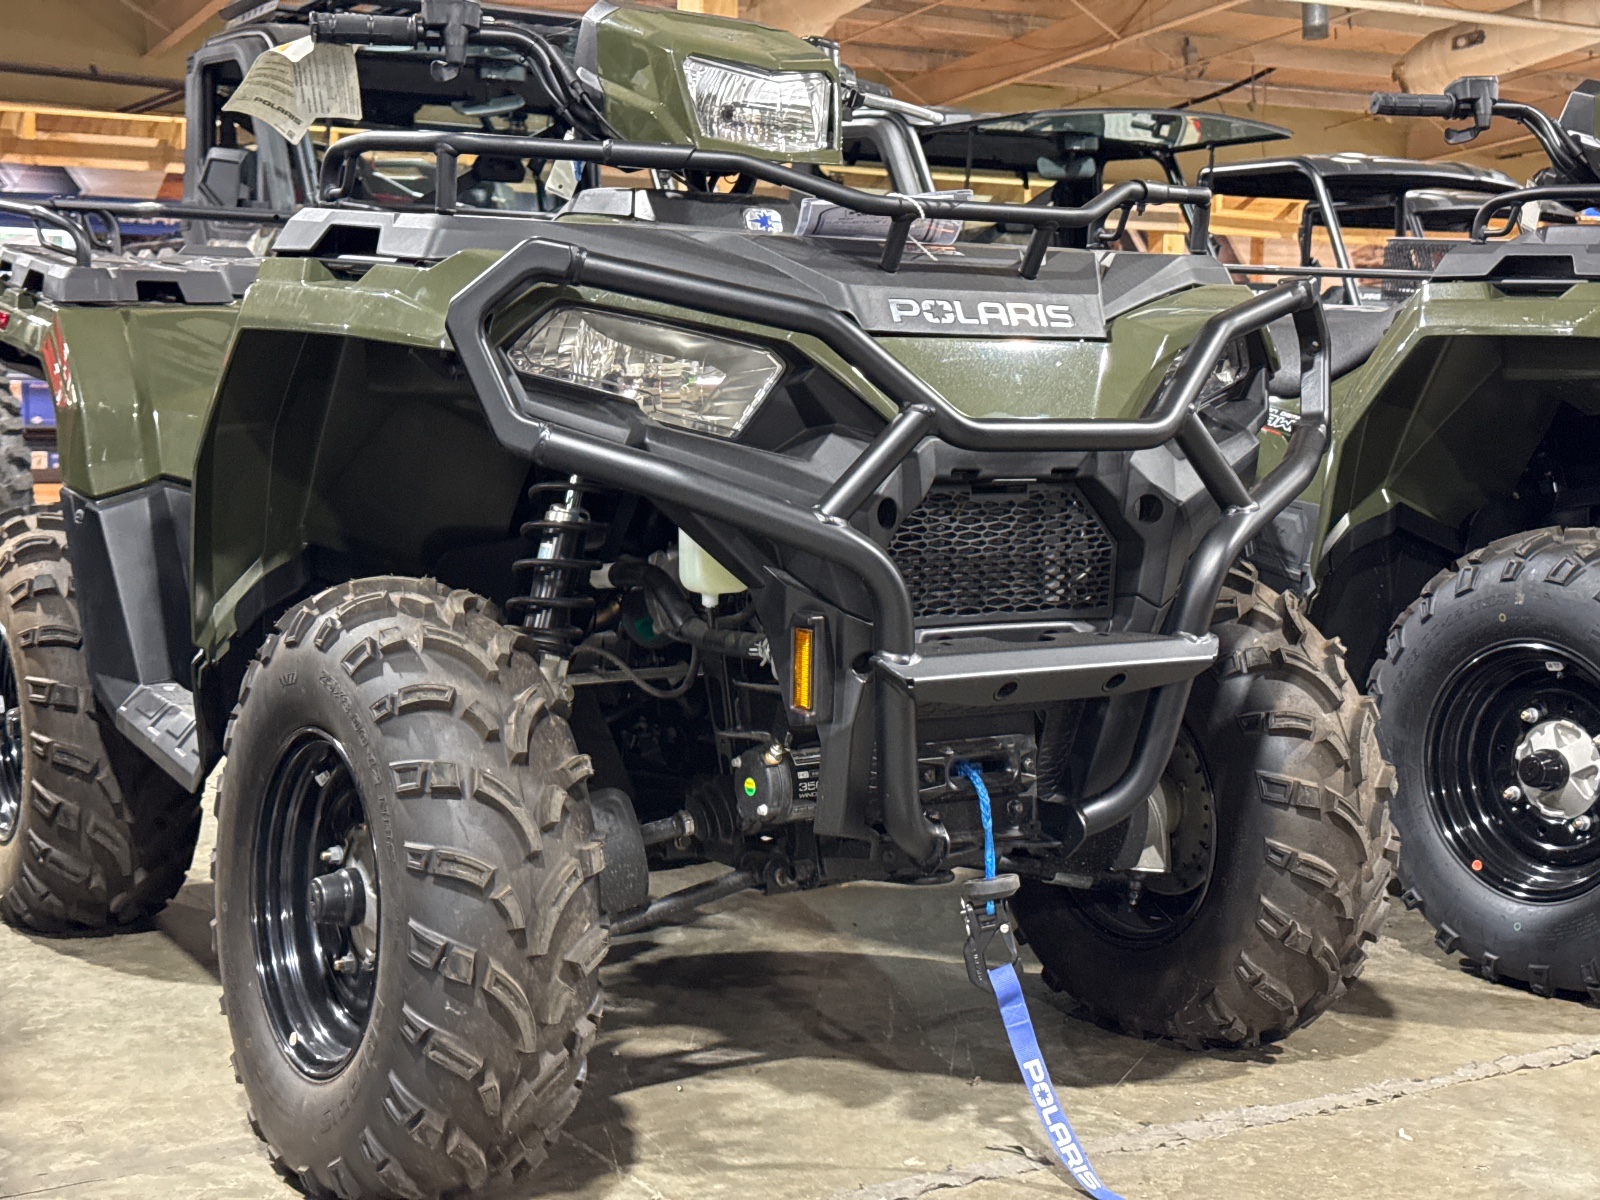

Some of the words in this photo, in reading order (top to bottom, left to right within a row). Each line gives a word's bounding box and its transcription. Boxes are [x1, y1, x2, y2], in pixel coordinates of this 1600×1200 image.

[254, 96, 302, 125] POLARIS
[888, 298, 1076, 328] POLARIS
[1022, 1058, 1101, 1191] POLARIS
